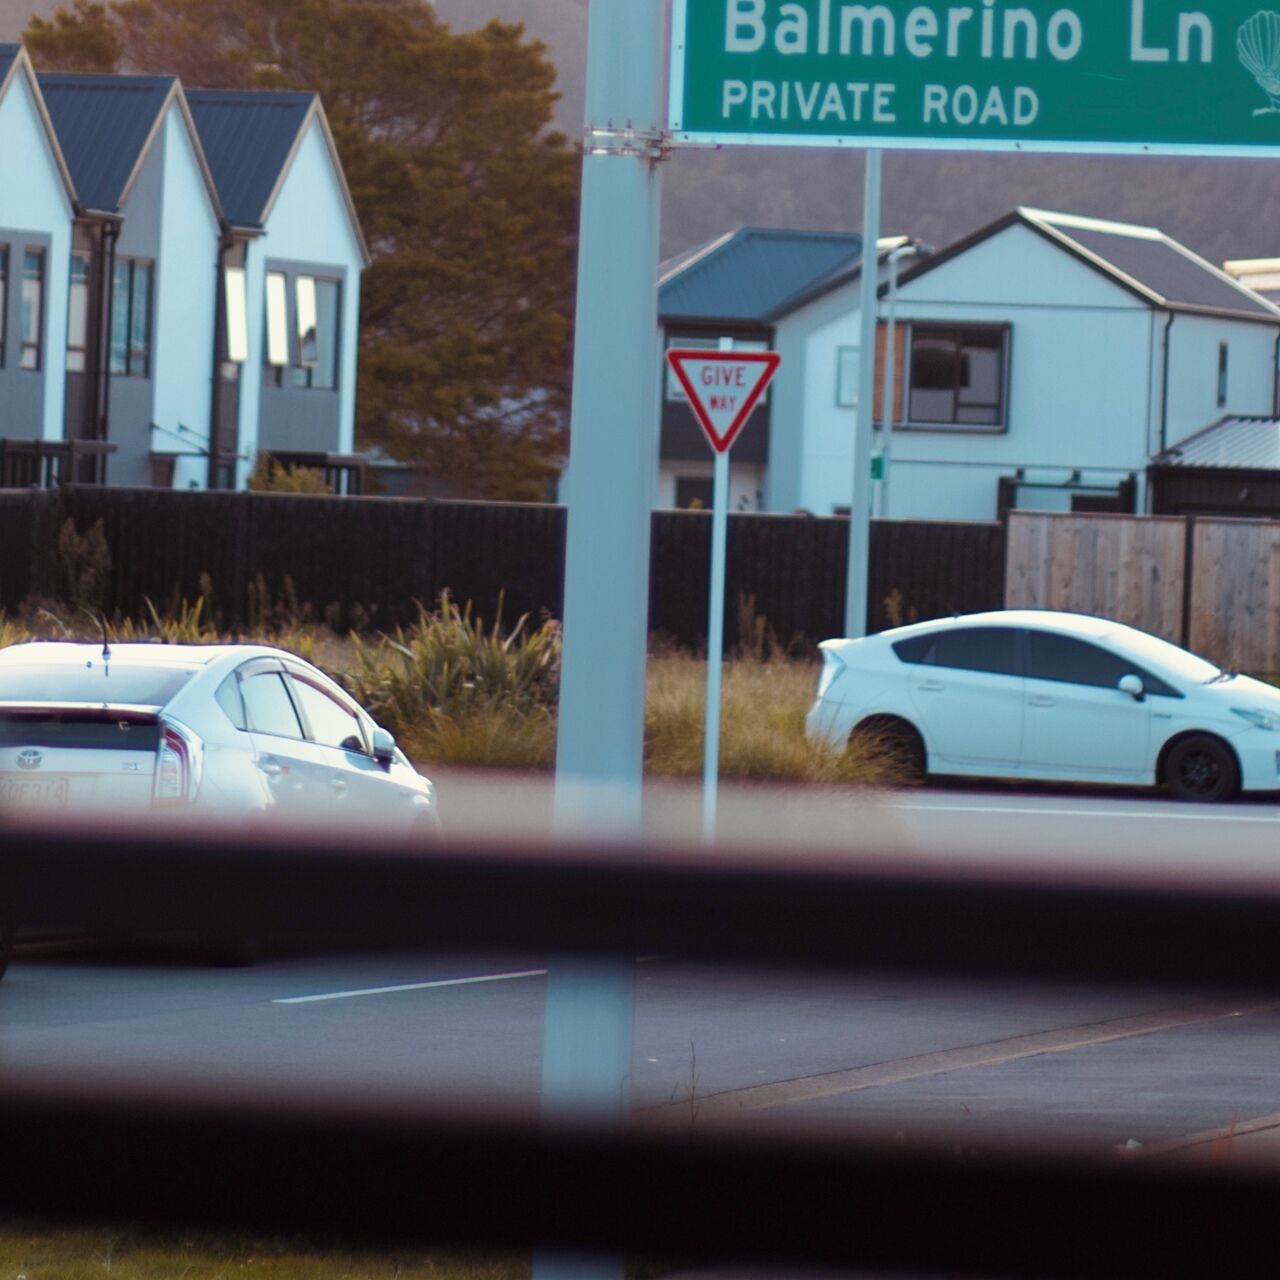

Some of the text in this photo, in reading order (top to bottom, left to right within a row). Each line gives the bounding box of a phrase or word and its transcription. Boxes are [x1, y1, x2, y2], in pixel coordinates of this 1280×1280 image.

[722, 79, 1039, 125] PRIVATE ROAD
[701, 365, 746, 387] GIVE
[709, 395, 736, 411] WAY
